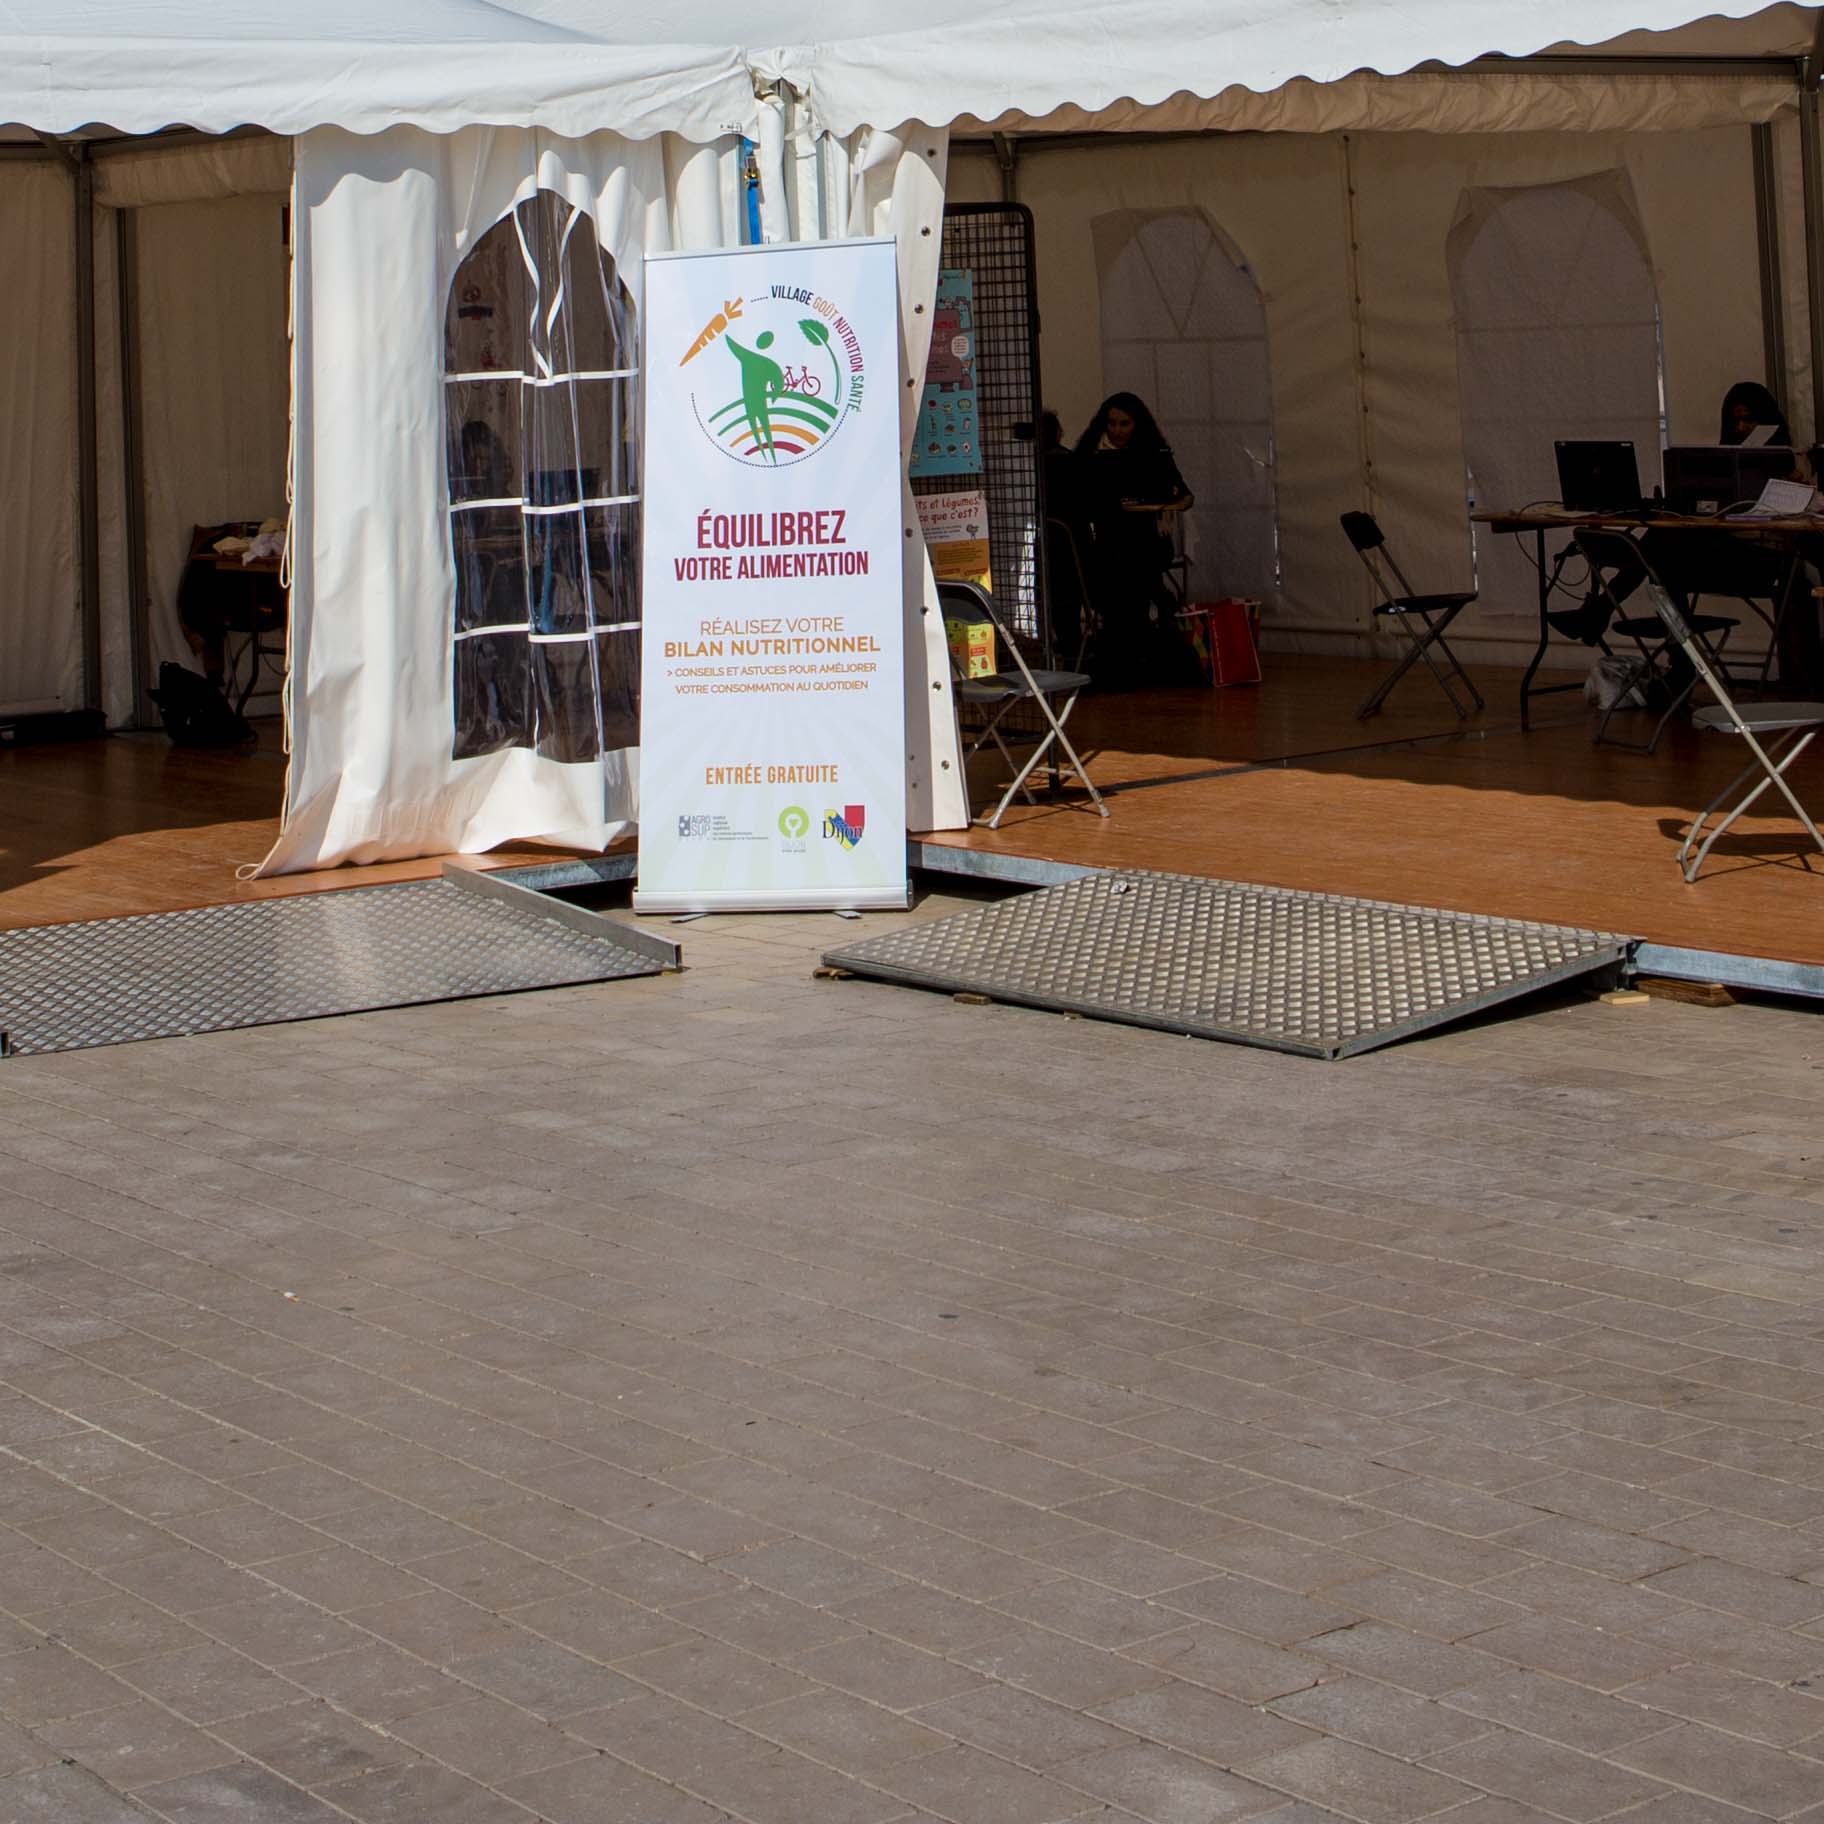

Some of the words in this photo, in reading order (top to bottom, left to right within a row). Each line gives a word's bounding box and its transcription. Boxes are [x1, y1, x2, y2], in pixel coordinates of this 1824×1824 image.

[772, 285, 814, 306] VILLAGE
[812, 296, 839, 320] GOÛT
[833, 316, 864, 372] NUTRITION
[848, 375, 864, 412] SANTÉ
[697, 509, 846, 550] ÉQUILIBREZ
[674, 556, 732, 582] VOTRE
[737, 550, 869, 580] ALIMENTATION
[700, 617, 782, 636] RÉALISEZ
[786, 616, 844, 633] VOTRE
[664, 640, 724, 658] BILAN
[731, 636, 881, 656] NUTRITIONNEL
[676, 666, 724, 678] CONSEILS
[727, 667, 740, 676] ET
[741, 665, 787, 676] ASTUCES
[788, 664, 817, 674] POUR
[819, 662, 877, 674] AMÉLIORER
[676, 684, 709, 695] VOTRE
[710, 682, 794, 694] CONSOMMATION
[796, 682, 811, 692] AU
[812, 680, 868, 692] QUOTIDIEN
[706, 763, 762, 785] ENTRÉE
[767, 764, 838, 784] GRATUITE
[822, 820, 862, 844] Dijon
